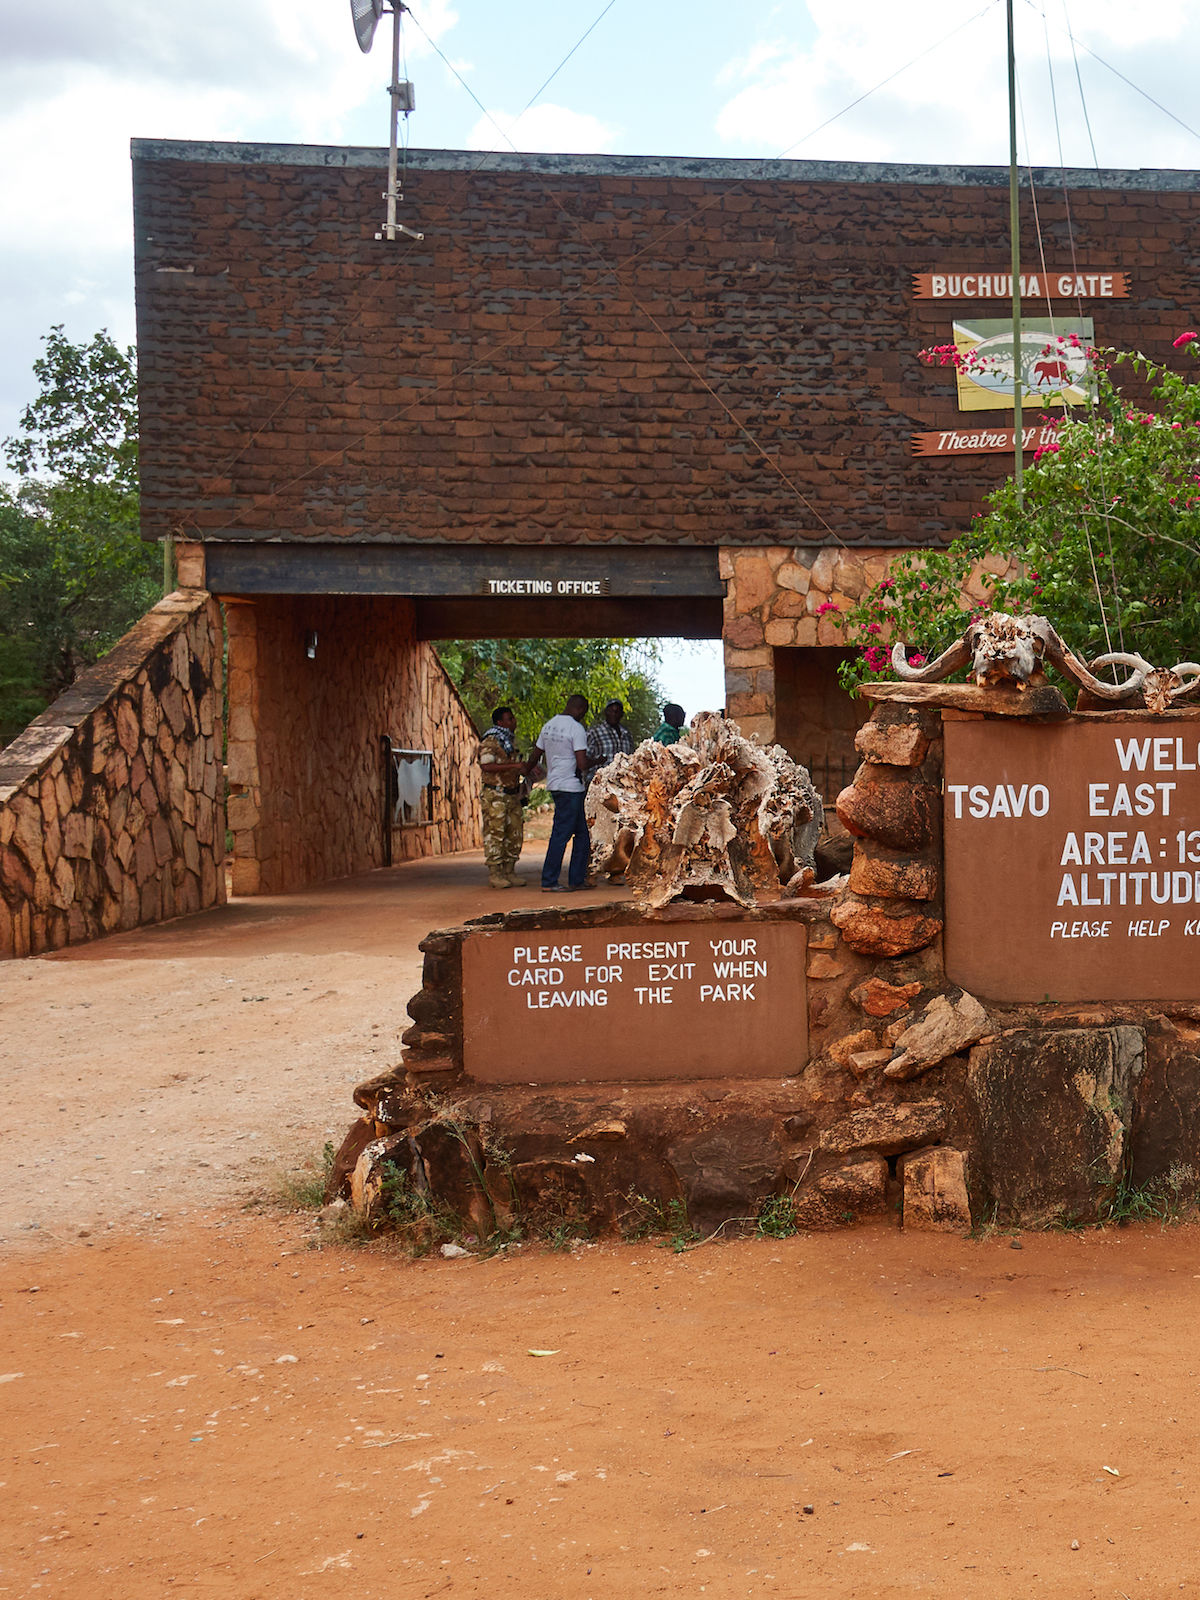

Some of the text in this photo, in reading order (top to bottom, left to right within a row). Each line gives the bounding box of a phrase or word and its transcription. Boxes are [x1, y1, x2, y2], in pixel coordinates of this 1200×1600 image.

[931, 275, 1114, 298] BUCHUMA GATE
[937, 430, 1008, 451] Theatre
[488, 579, 601, 595] TICKETING OFFICE
[947, 783, 1050, 819] TSAVO
[1088, 782, 1177, 817] EAST
[1050, 920, 1112, 938] PLEASE
[1127, 919, 1170, 937] HELP
[513, 938, 757, 964] PLEASE PRESENT YOUR
[507, 960, 768, 987] CARD FOR EXIT WHEN
[526, 983, 756, 1009] LEAVING THE PARK
